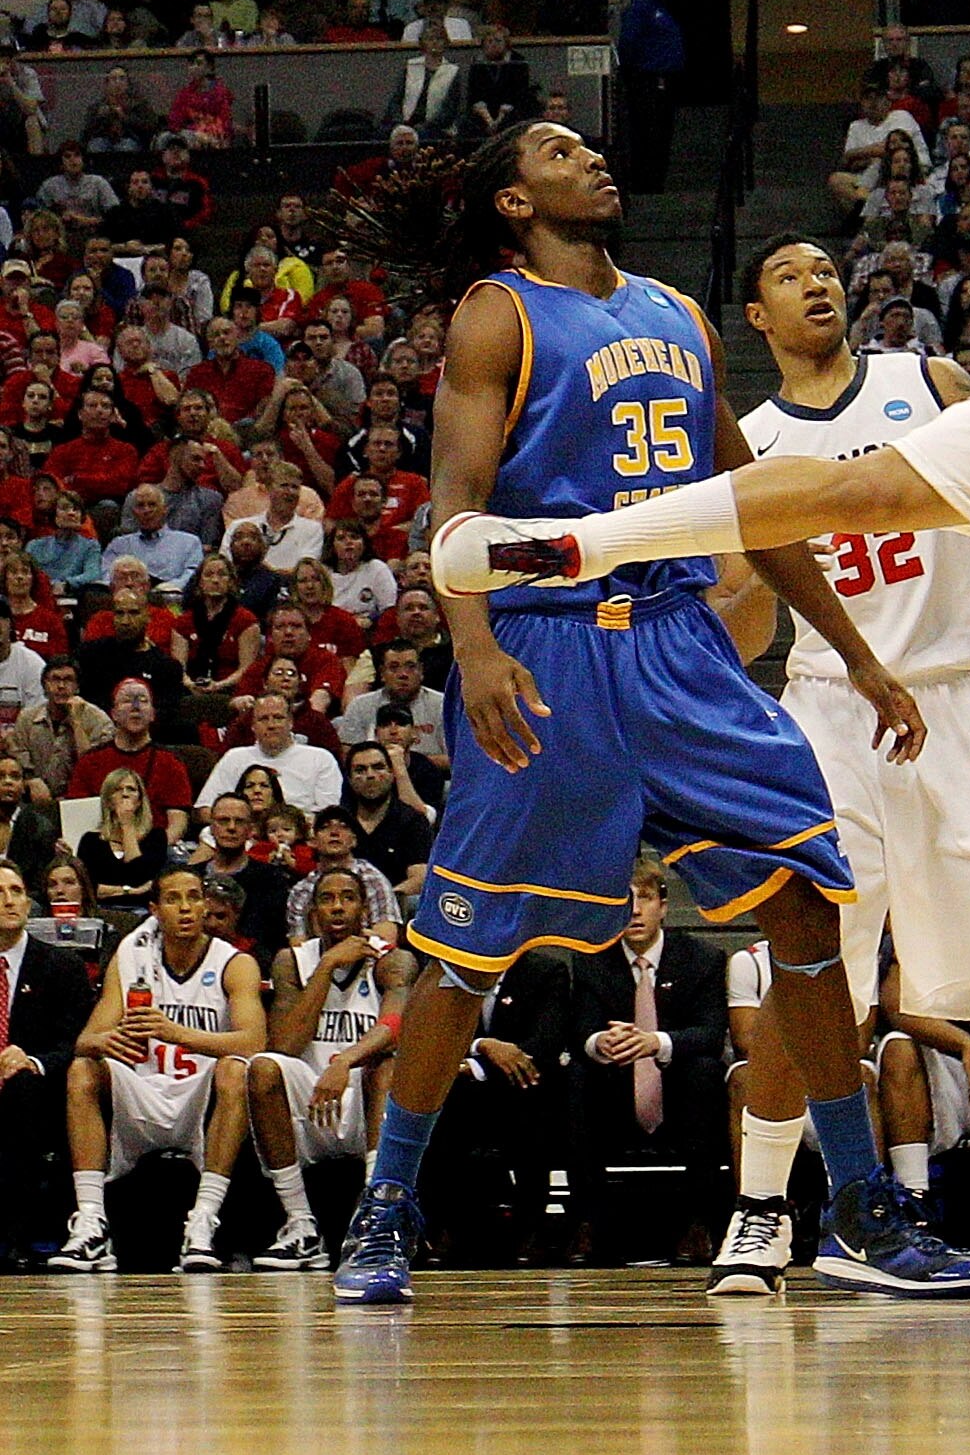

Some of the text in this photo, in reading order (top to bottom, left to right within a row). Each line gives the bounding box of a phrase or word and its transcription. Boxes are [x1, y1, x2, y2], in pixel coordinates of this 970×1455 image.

[586, 337, 704, 402] MOREHEAD
[612, 398, 694, 476] 35
[832, 532, 925, 598] 32
[444, 900, 470, 918] OVC
[155, 1043, 198, 1080] 15
